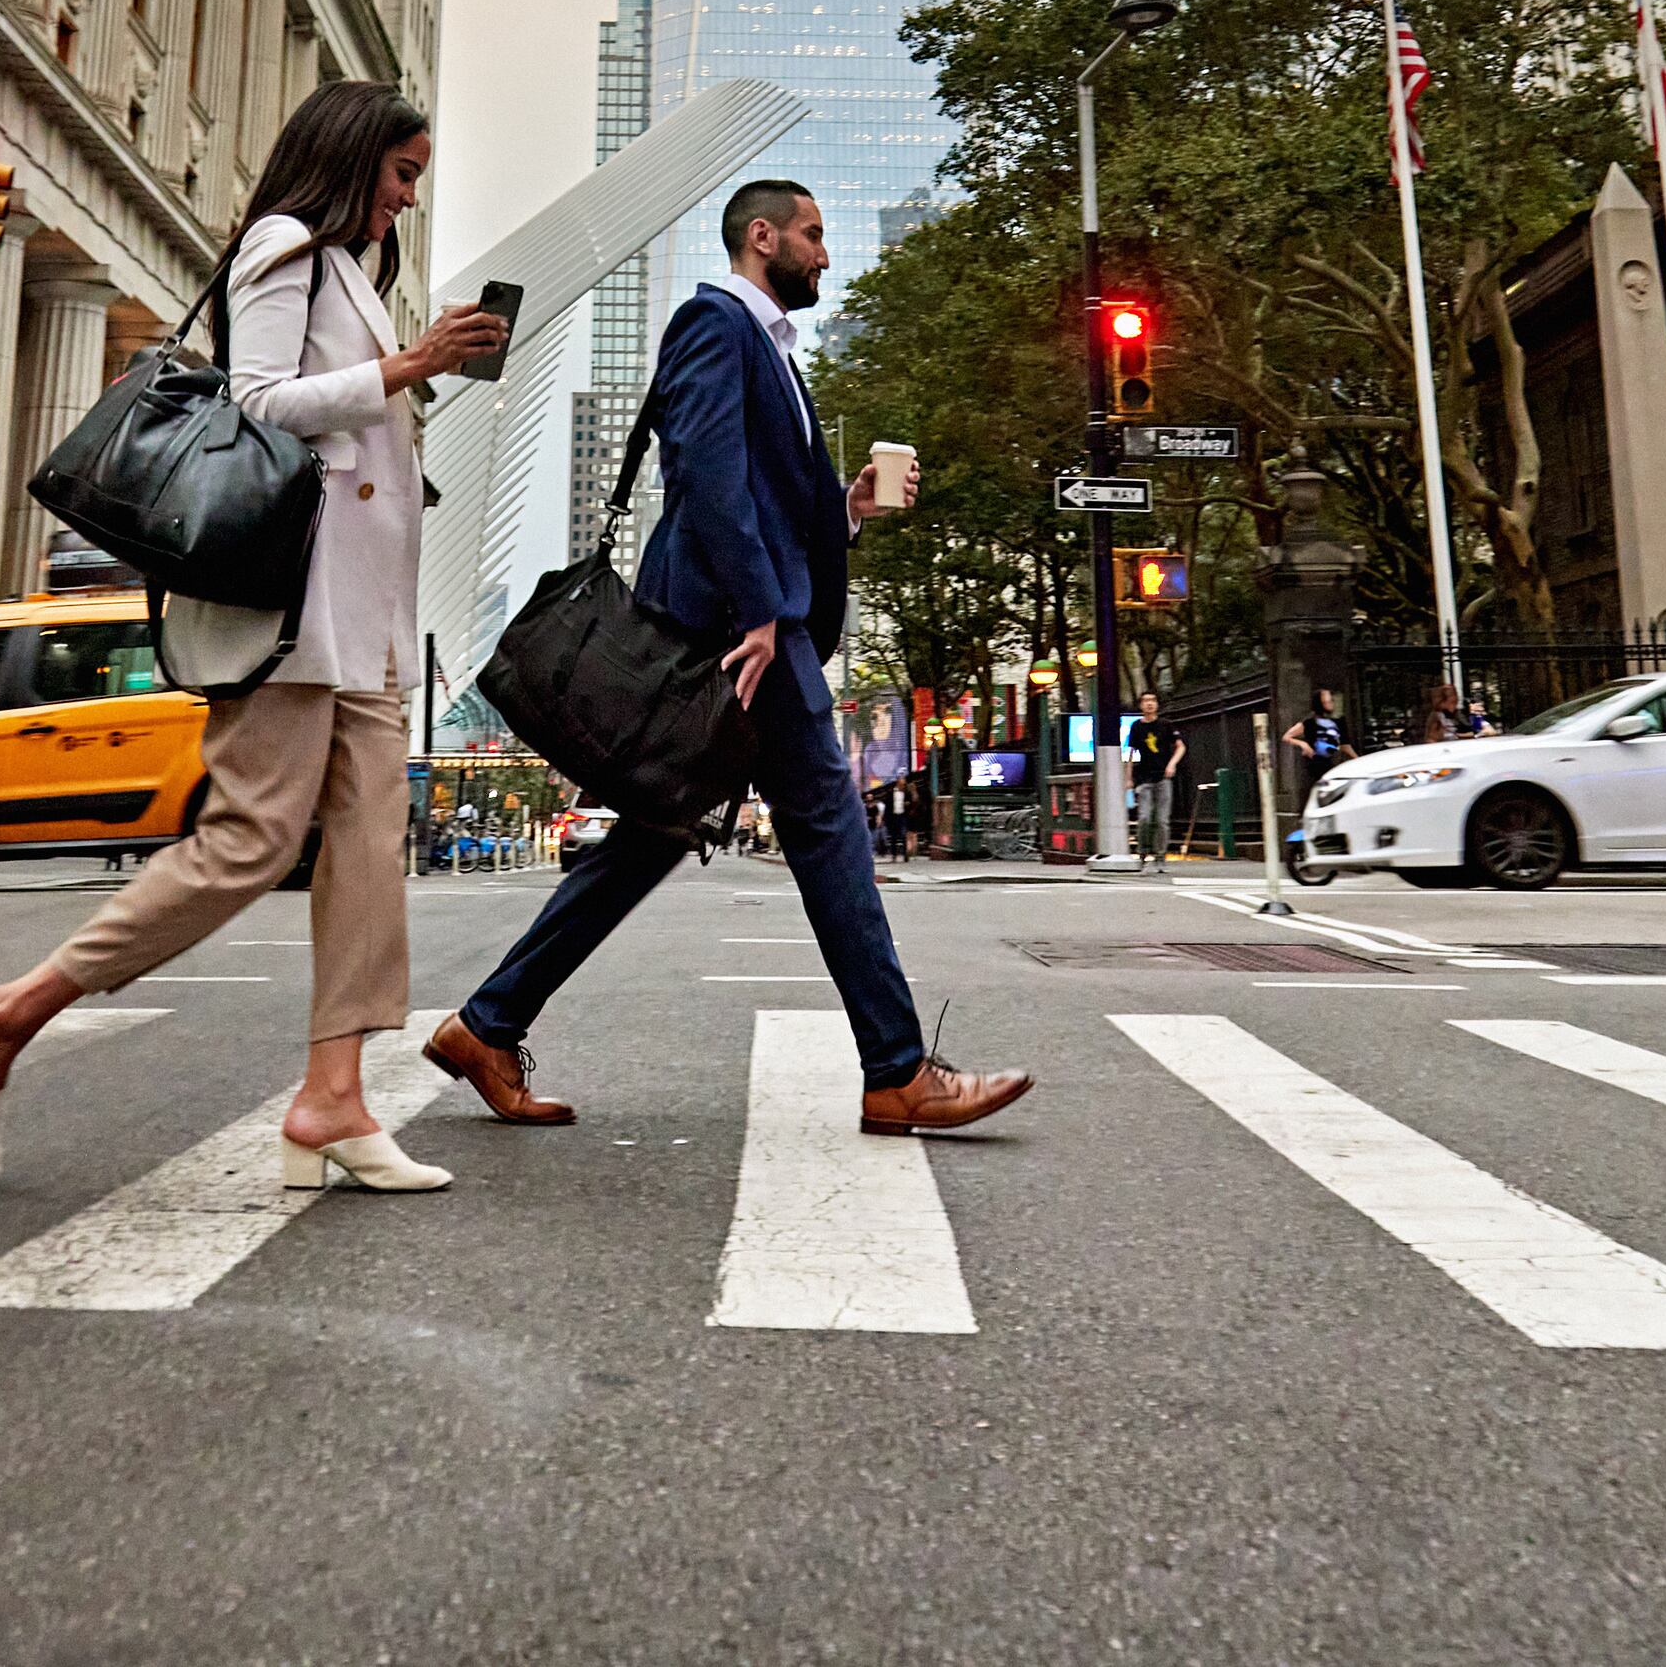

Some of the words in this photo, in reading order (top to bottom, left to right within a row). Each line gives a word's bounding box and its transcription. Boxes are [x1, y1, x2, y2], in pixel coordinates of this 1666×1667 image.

[1159, 435, 1231, 454] Broadway
[1071, 488, 1098, 500] ONE
[1111, 488, 1138, 501] WAY
